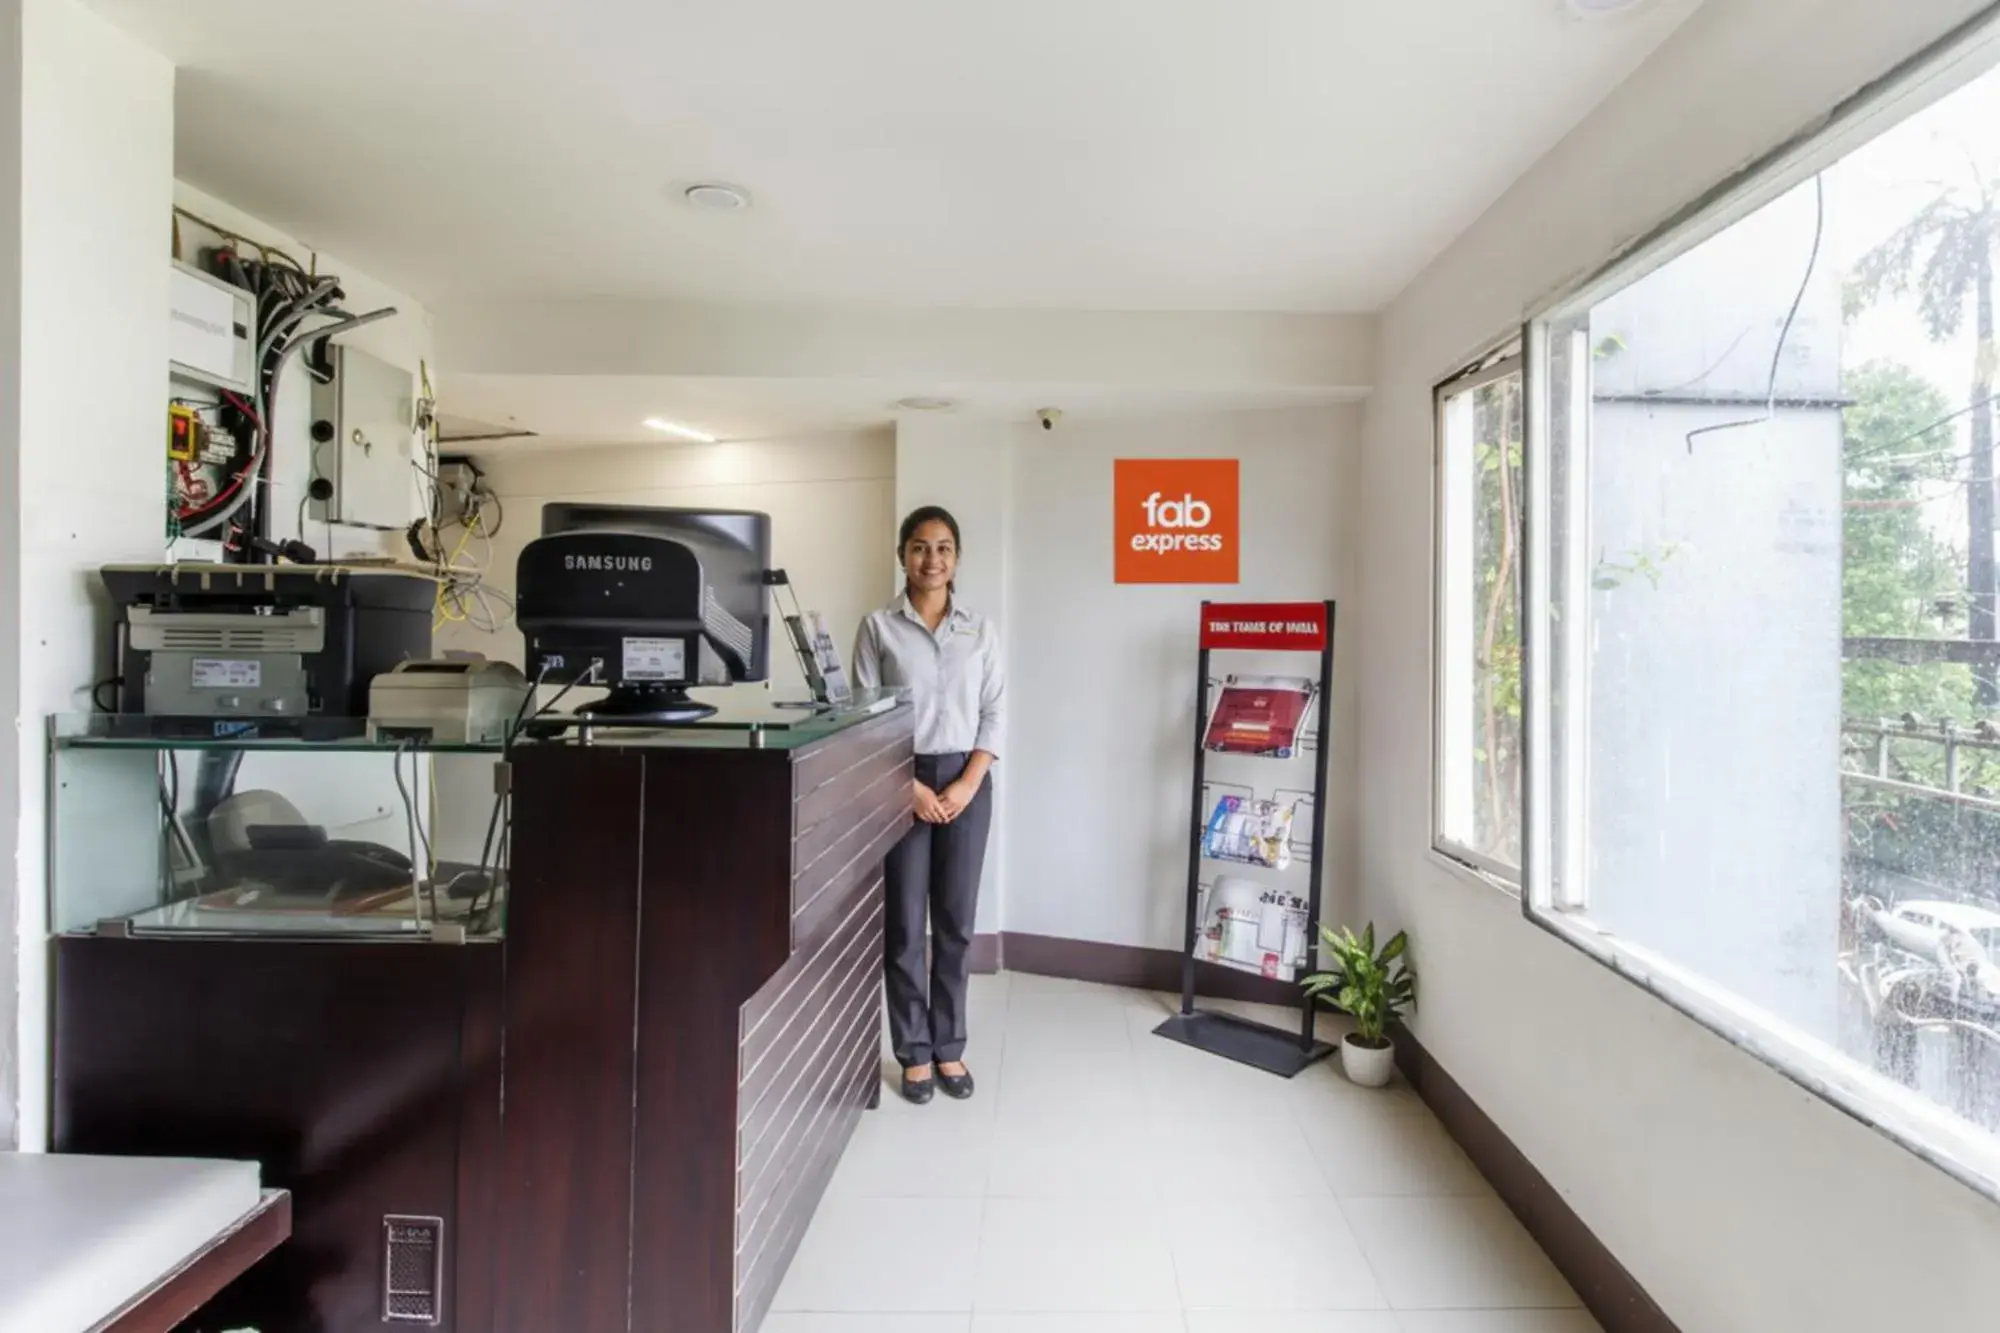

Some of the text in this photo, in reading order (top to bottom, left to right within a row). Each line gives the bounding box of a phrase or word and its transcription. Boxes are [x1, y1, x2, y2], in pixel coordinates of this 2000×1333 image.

[1141, 491, 1212, 528] fab
[1130, 533, 1223, 556] express
[564, 555, 653, 571] SAMSUNG
